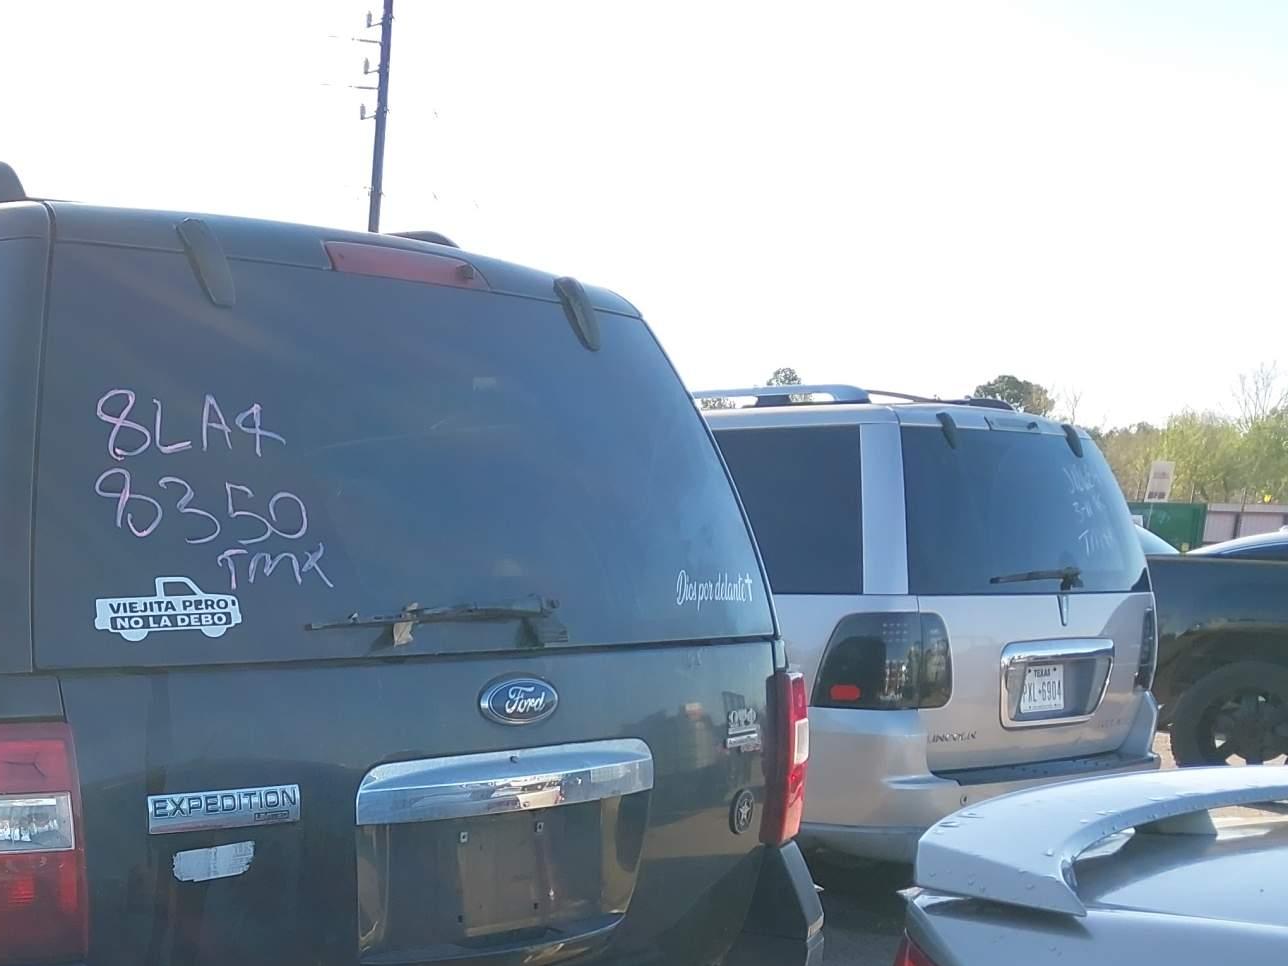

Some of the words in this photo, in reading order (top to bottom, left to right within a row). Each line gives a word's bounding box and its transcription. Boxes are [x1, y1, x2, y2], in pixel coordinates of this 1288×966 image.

[95, 467, 308, 546] 8350
[676, 569, 697, 606] Dios
[697, 580, 713, 612] por
[109, 600, 177, 614] VIEJITA
[182, 599, 229, 612] PERO
[116, 616, 144, 630] NO
[148, 615, 172, 628] LA
[176, 613, 228, 627] DEBO
[505, 686, 546, 713] Ford
[153, 788, 297, 818] EXPEDITION
